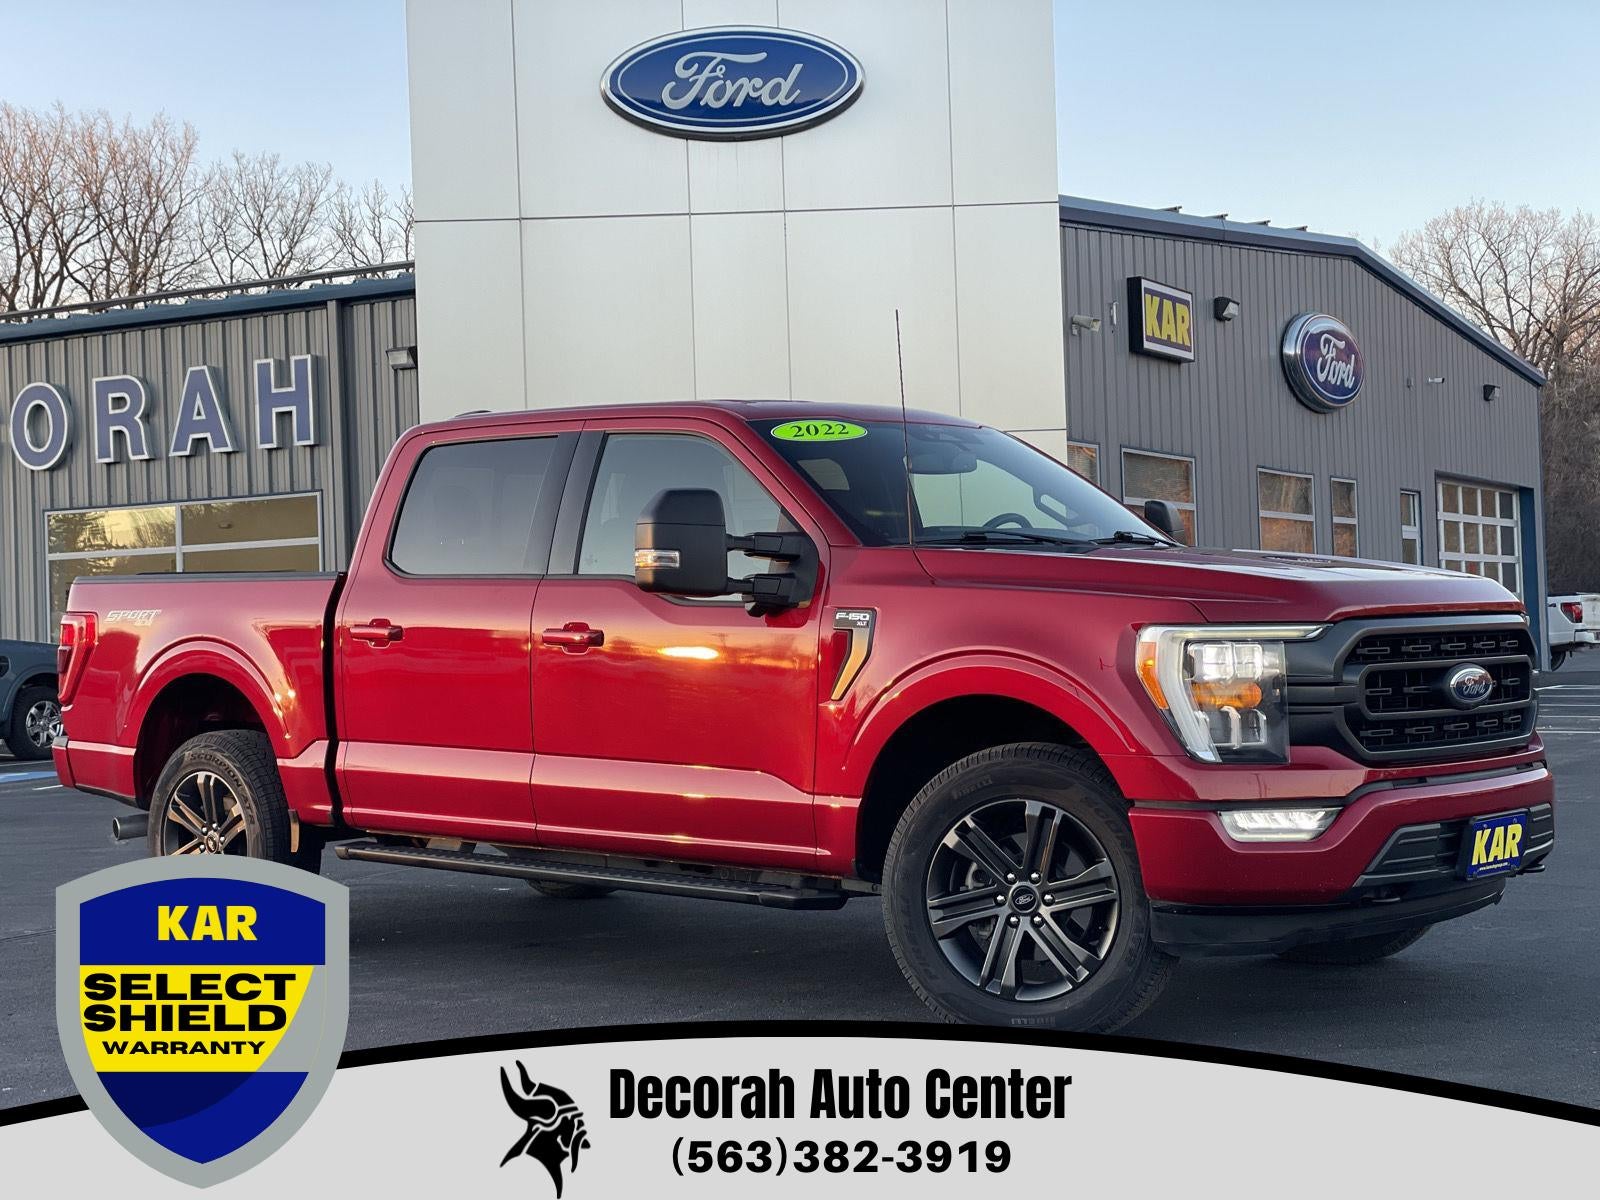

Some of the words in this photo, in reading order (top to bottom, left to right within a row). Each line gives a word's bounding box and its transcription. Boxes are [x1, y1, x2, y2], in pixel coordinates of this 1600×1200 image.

[661, 51, 803, 110] Ford
[1144, 294, 1191, 347] KAR
[1316, 333, 1355, 389] Ford
[10, 354, 319, 471] ORAH
[790, 423, 849, 438] 2022
[104, 609, 162, 623] SPORT
[835, 612, 870, 621] F-150
[1462, 675, 1486, 695] Ford
[1471, 823, 1523, 866] KAR
